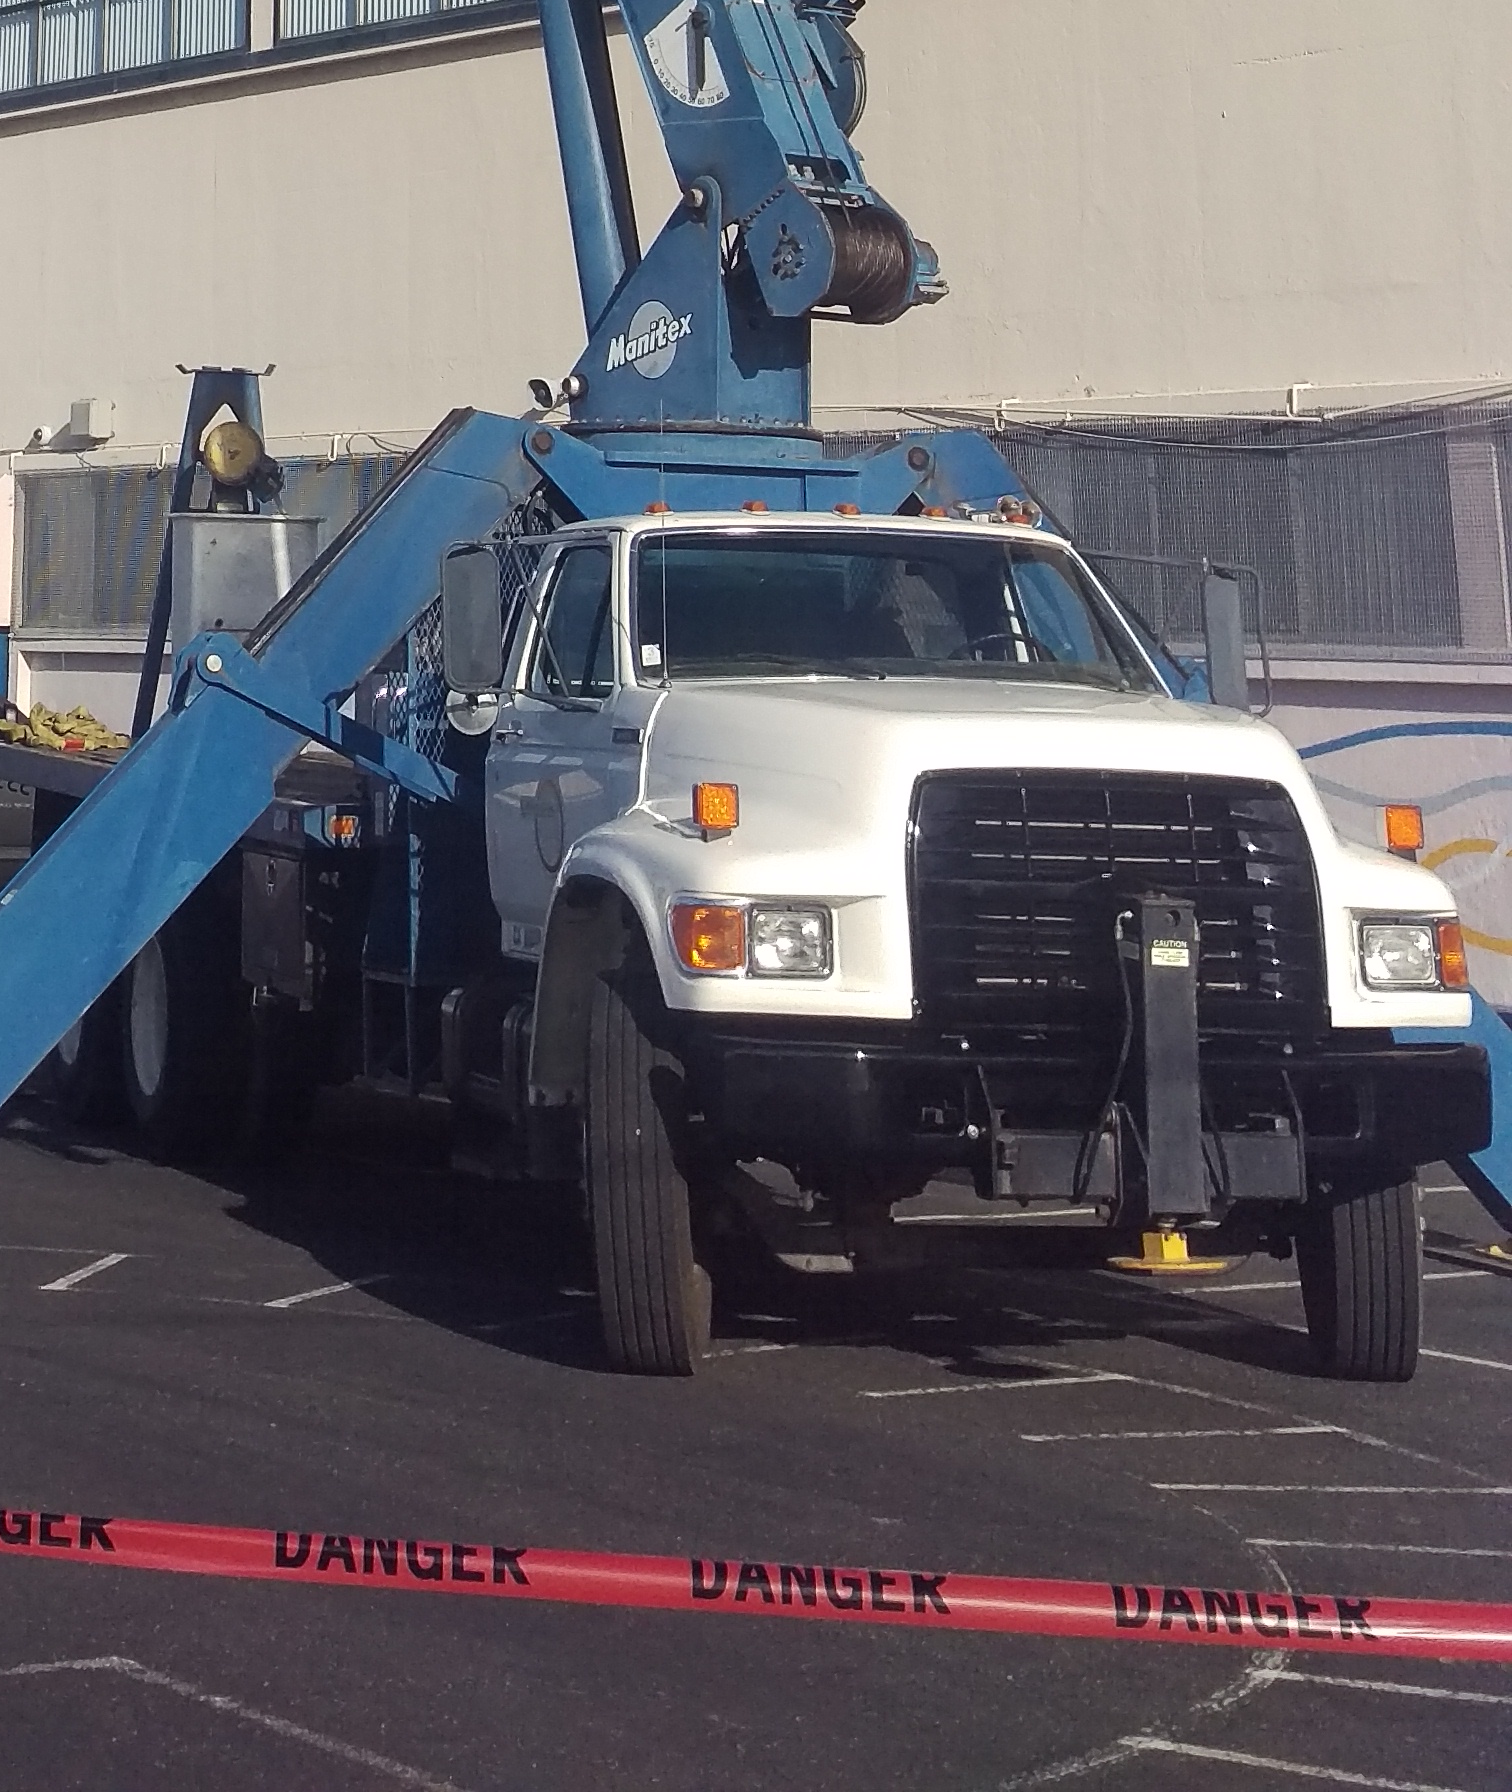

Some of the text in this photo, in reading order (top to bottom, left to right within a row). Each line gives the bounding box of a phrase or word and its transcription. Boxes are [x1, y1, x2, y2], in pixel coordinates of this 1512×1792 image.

[657, 68, 665, 79] 10
[663, 78, 671, 89] 20
[606, 312, 694, 372] Manitex
[1152, 939, 1187, 948] CAUTION
[275, 1532, 531, 1585] DANGER
[691, 1559, 952, 1615] DANGER
[1111, 1585, 1379, 1641] DANGER
